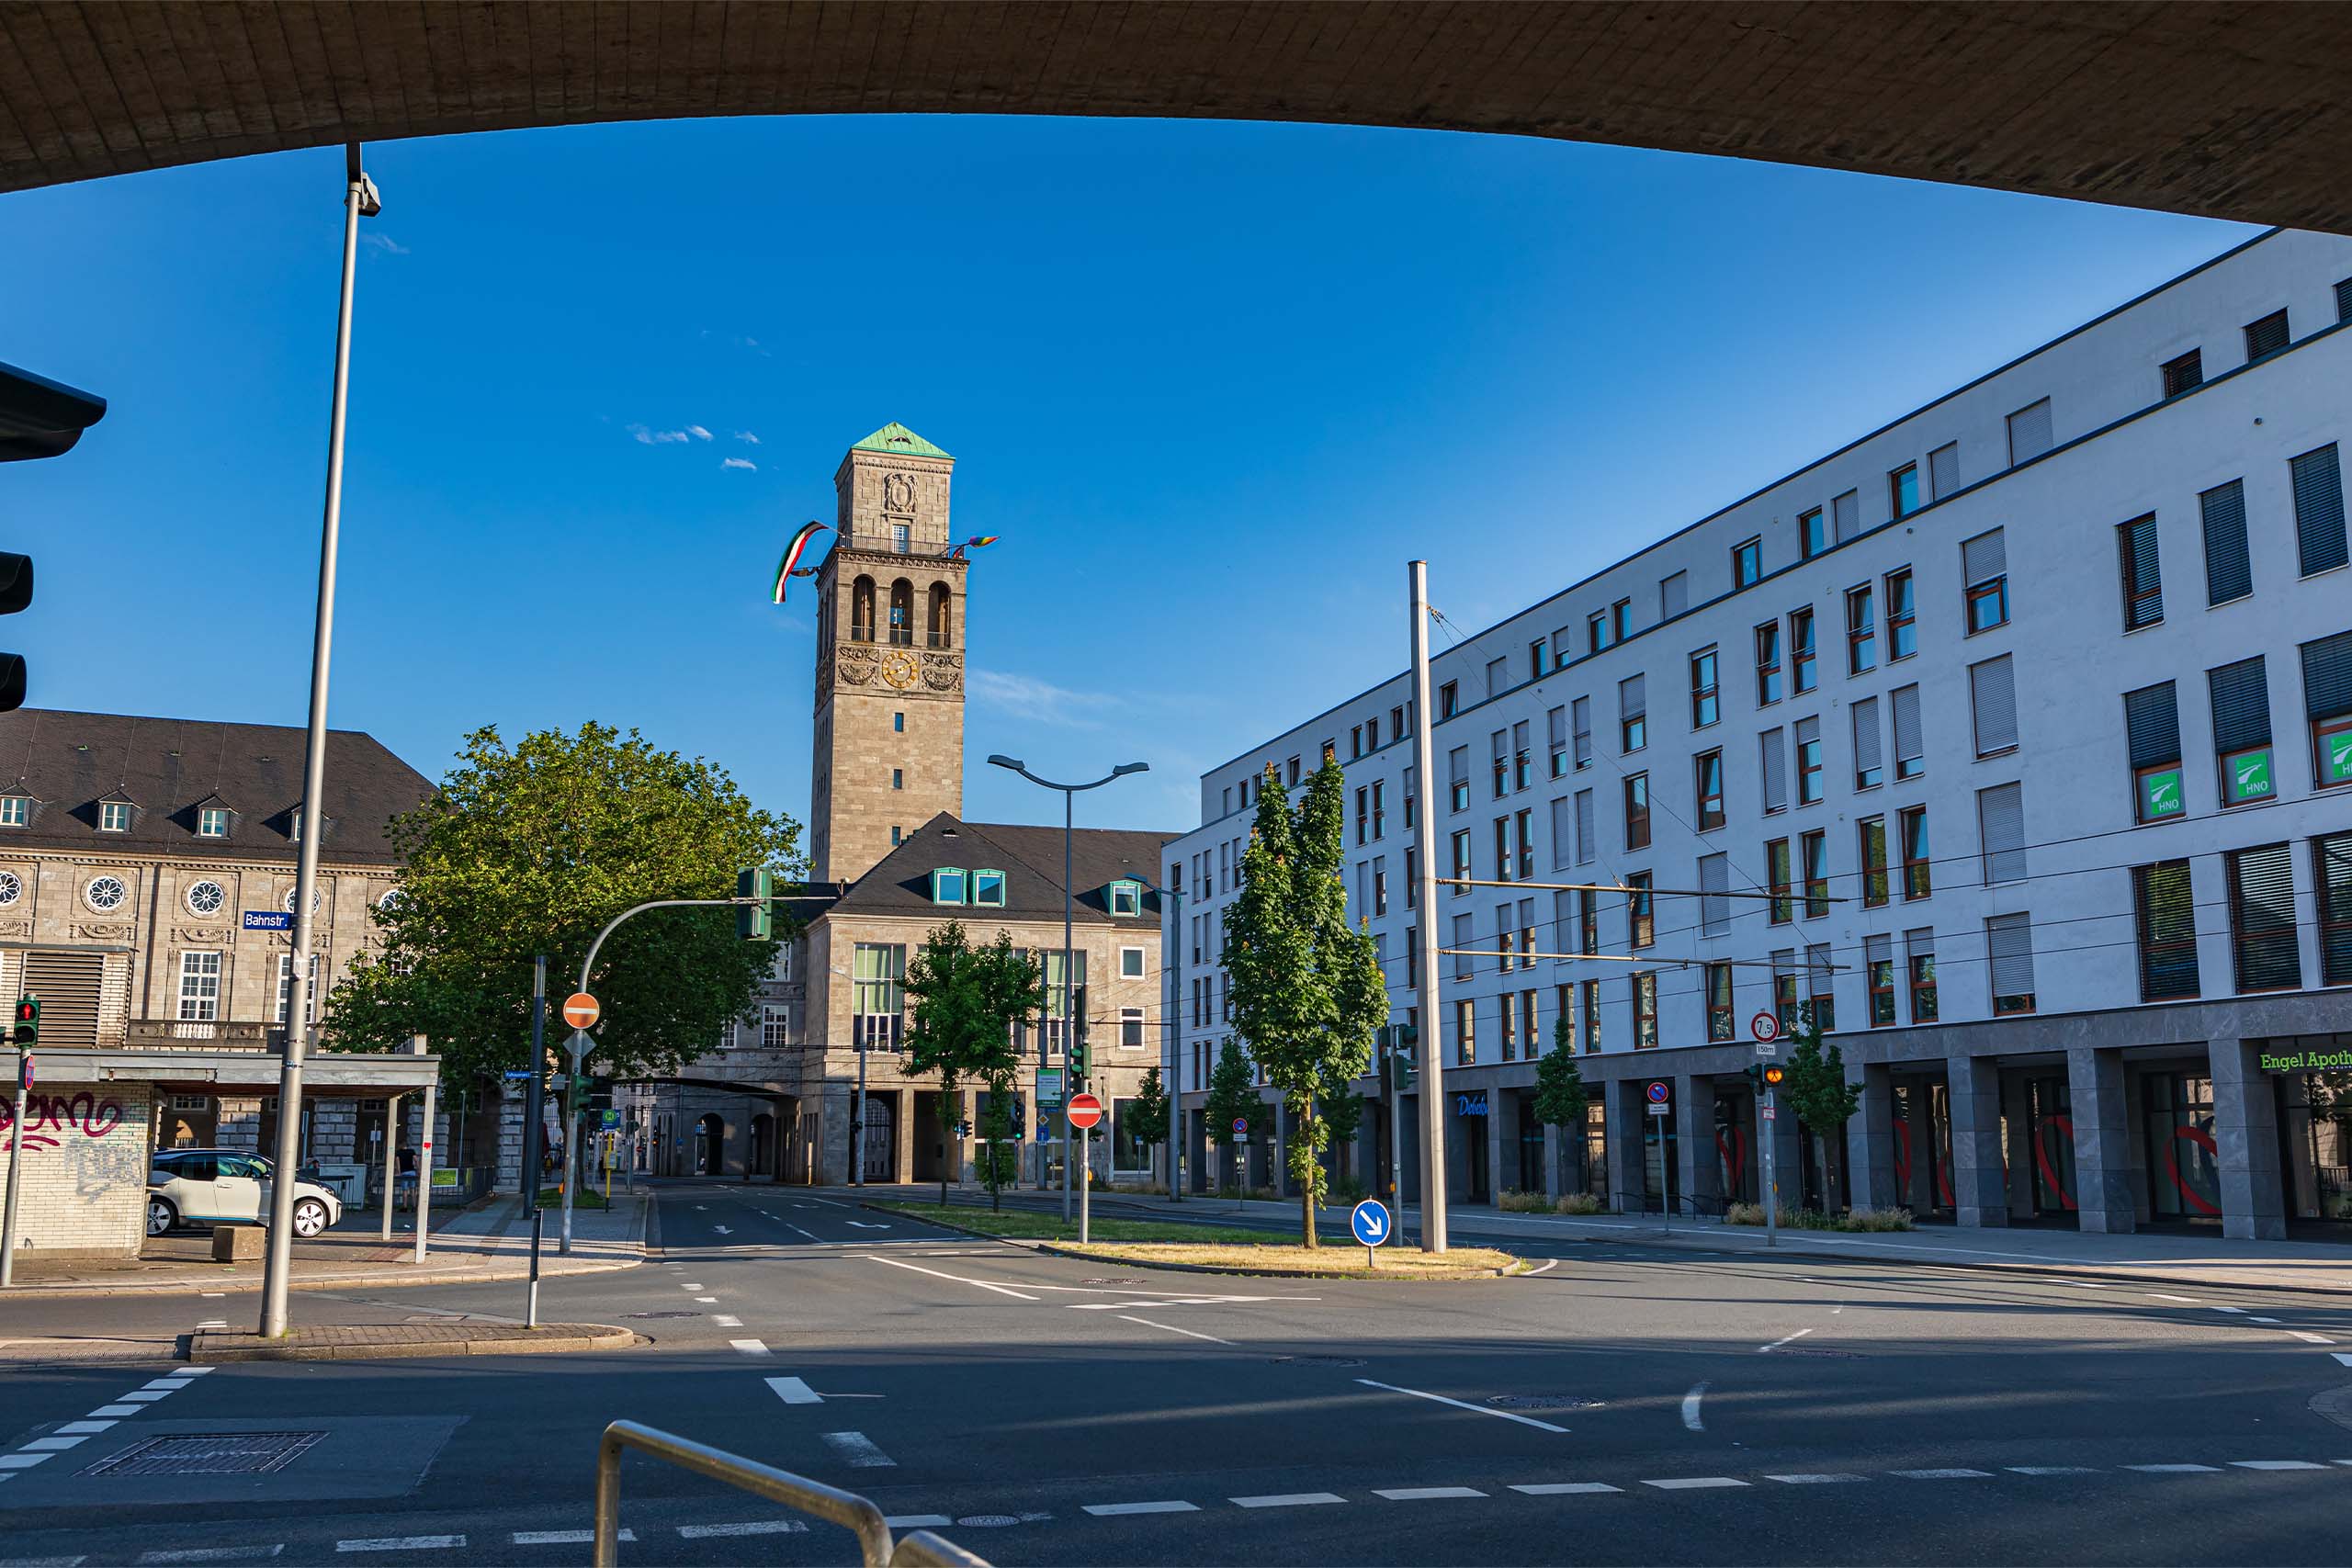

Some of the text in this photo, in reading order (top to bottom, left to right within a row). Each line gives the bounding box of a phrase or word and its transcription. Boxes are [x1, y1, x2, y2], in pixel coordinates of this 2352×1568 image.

[2246, 781, 2268, 794] HNO
[2159, 799, 2178, 811] HNO
[245, 914, 288, 927] Bahnstr.
[2260, 1050, 2352, 1072] Engel Apoth
